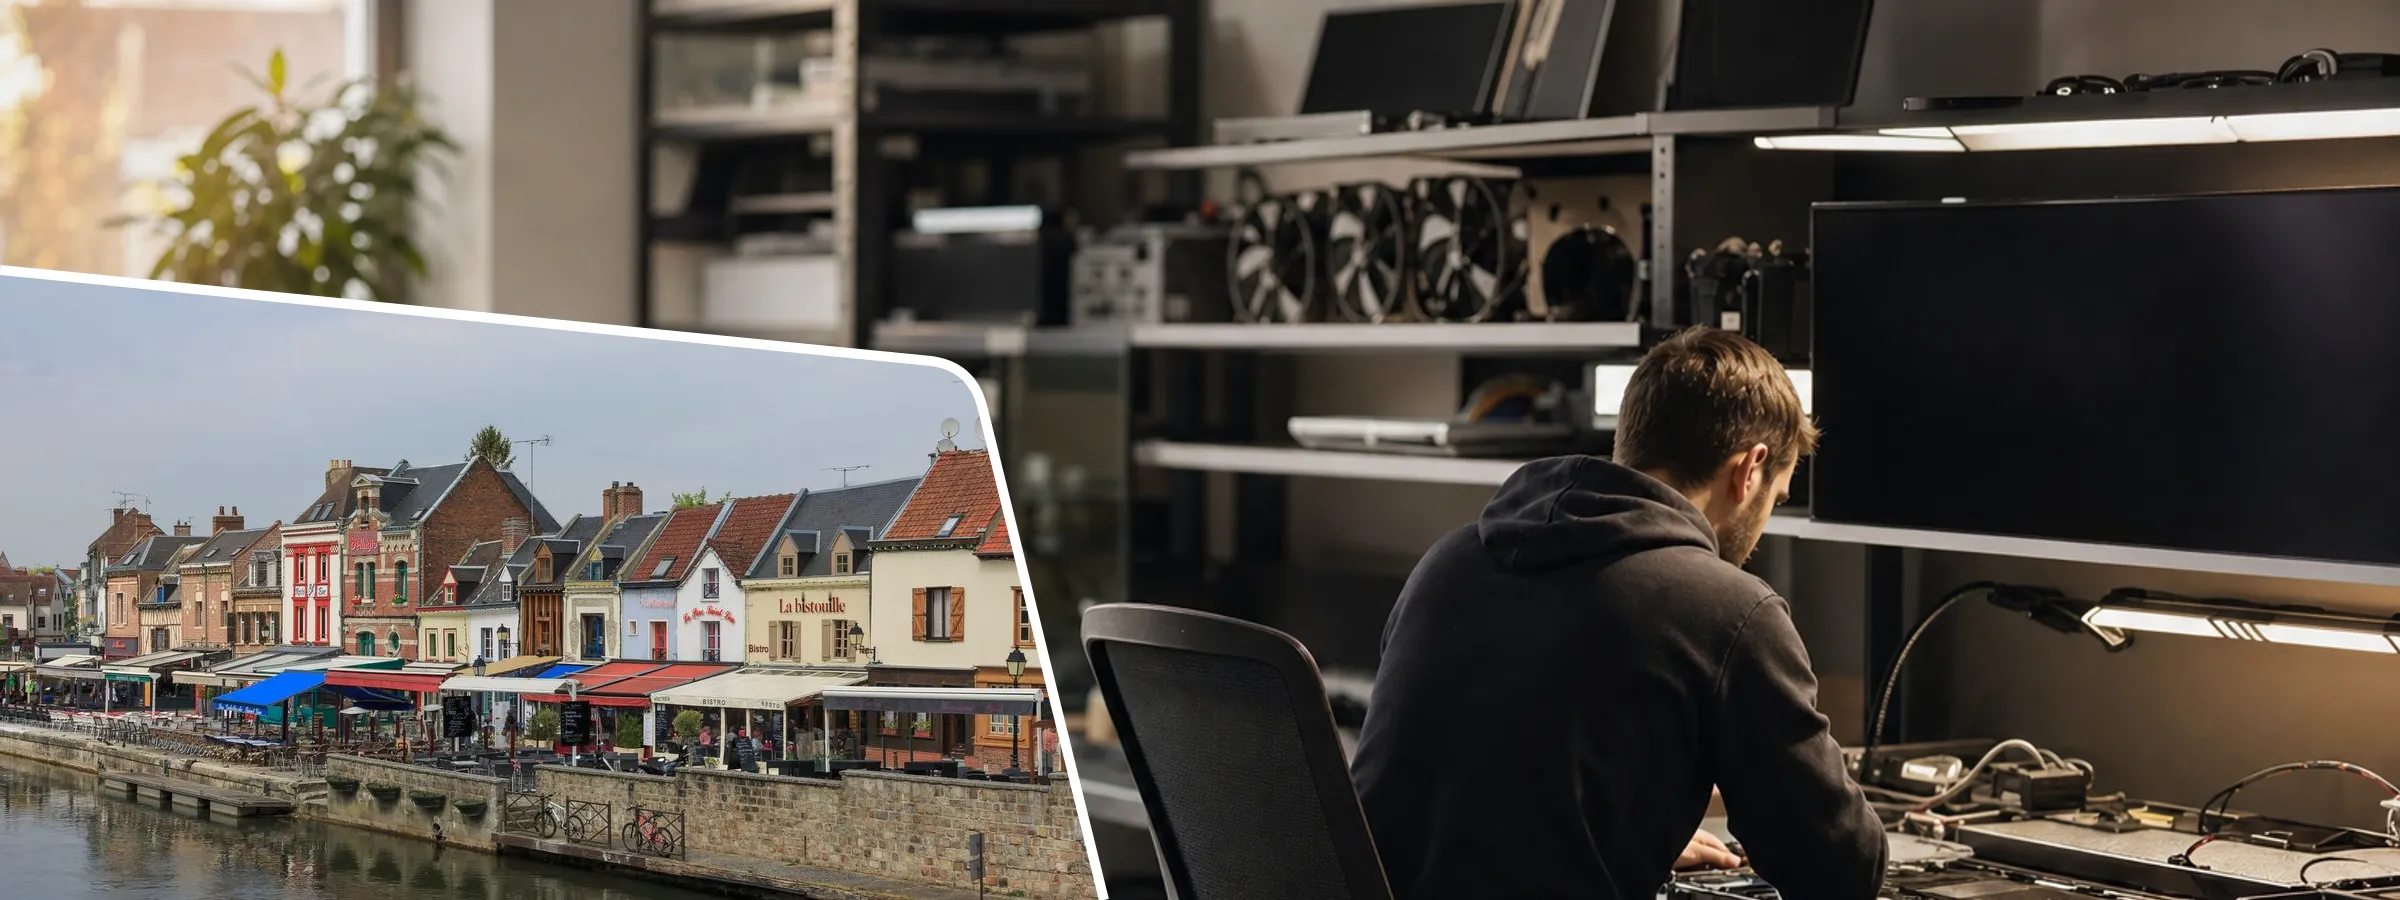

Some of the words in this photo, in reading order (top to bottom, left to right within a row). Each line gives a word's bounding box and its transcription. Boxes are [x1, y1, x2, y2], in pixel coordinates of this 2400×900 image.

[779, 598, 792, 613] La
[795, 597, 846, 613] bistouille
[749, 645, 769, 653] Bistro
